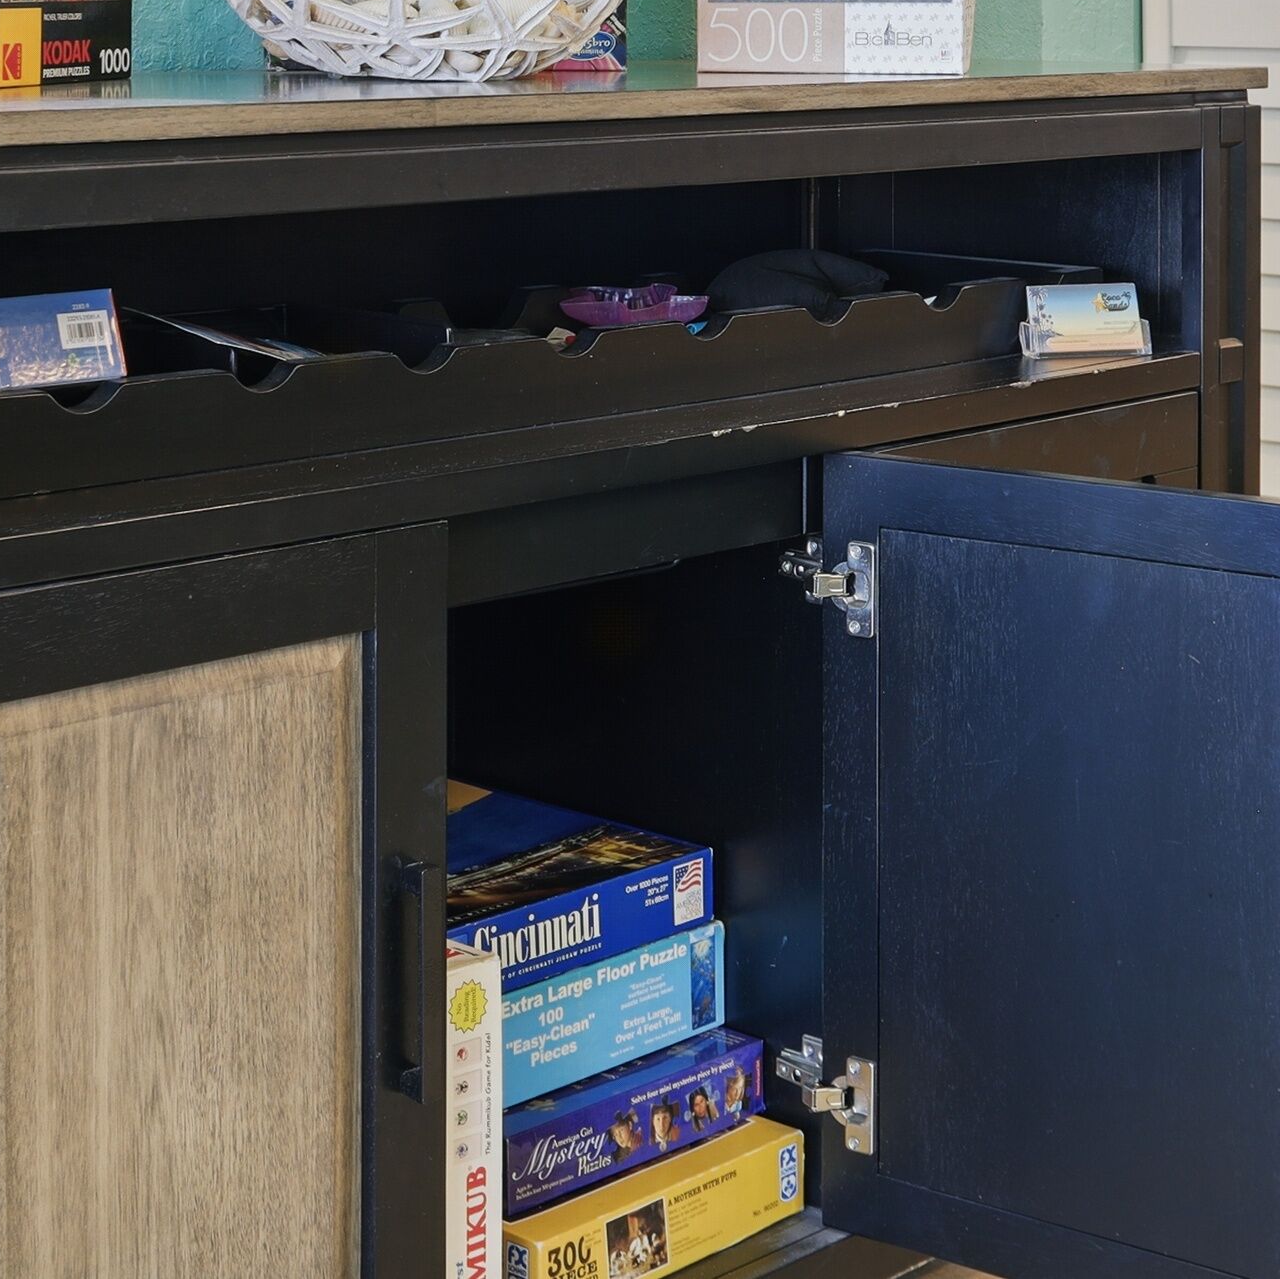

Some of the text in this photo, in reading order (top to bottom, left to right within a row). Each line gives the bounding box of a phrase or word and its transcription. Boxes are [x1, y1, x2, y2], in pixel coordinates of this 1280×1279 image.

[707, 7, 809, 63] 500
[812, 7, 823, 63] Piece Puzzle
[895, 31, 932, 46] Ben
[43, 40, 91, 65] KODAK
[100, 48, 130, 74] 1000
[43, 66, 90, 78] PREMIUM PUZZLES
[625, 884, 639, 894] Over
[651, 875, 669, 886] Pieces
[473, 893, 602, 969] Cincinnati
[508, 942, 602, 979] OF CINCINNATI JIGSAW PUZZLE
[502, 943, 688, 1019] Extra Large Floor Puzzle
[539, 1006, 564, 1027] 100
[623, 1016, 646, 1029] Extra
[616, 1031, 635, 1044] Over
[636, 1026, 642, 1035] 4
[644, 1020, 662, 1033] Feet
[531, 1041, 578, 1067] Pieces
[631, 1094, 646, 1105] Solve
[646, 1089, 658, 1100] four
[659, 1083, 671, 1094] mini
[672, 1074, 697, 1090] mysteries
[697, 1070, 710, 1081] piece
[711, 1065, 718, 1076] by
[552, 1126, 594, 1150] American Girl
[512, 1132, 606, 1181] Mystery
[578, 1154, 612, 1177] Puzzles
[702, 1177, 720, 1191] WITH
